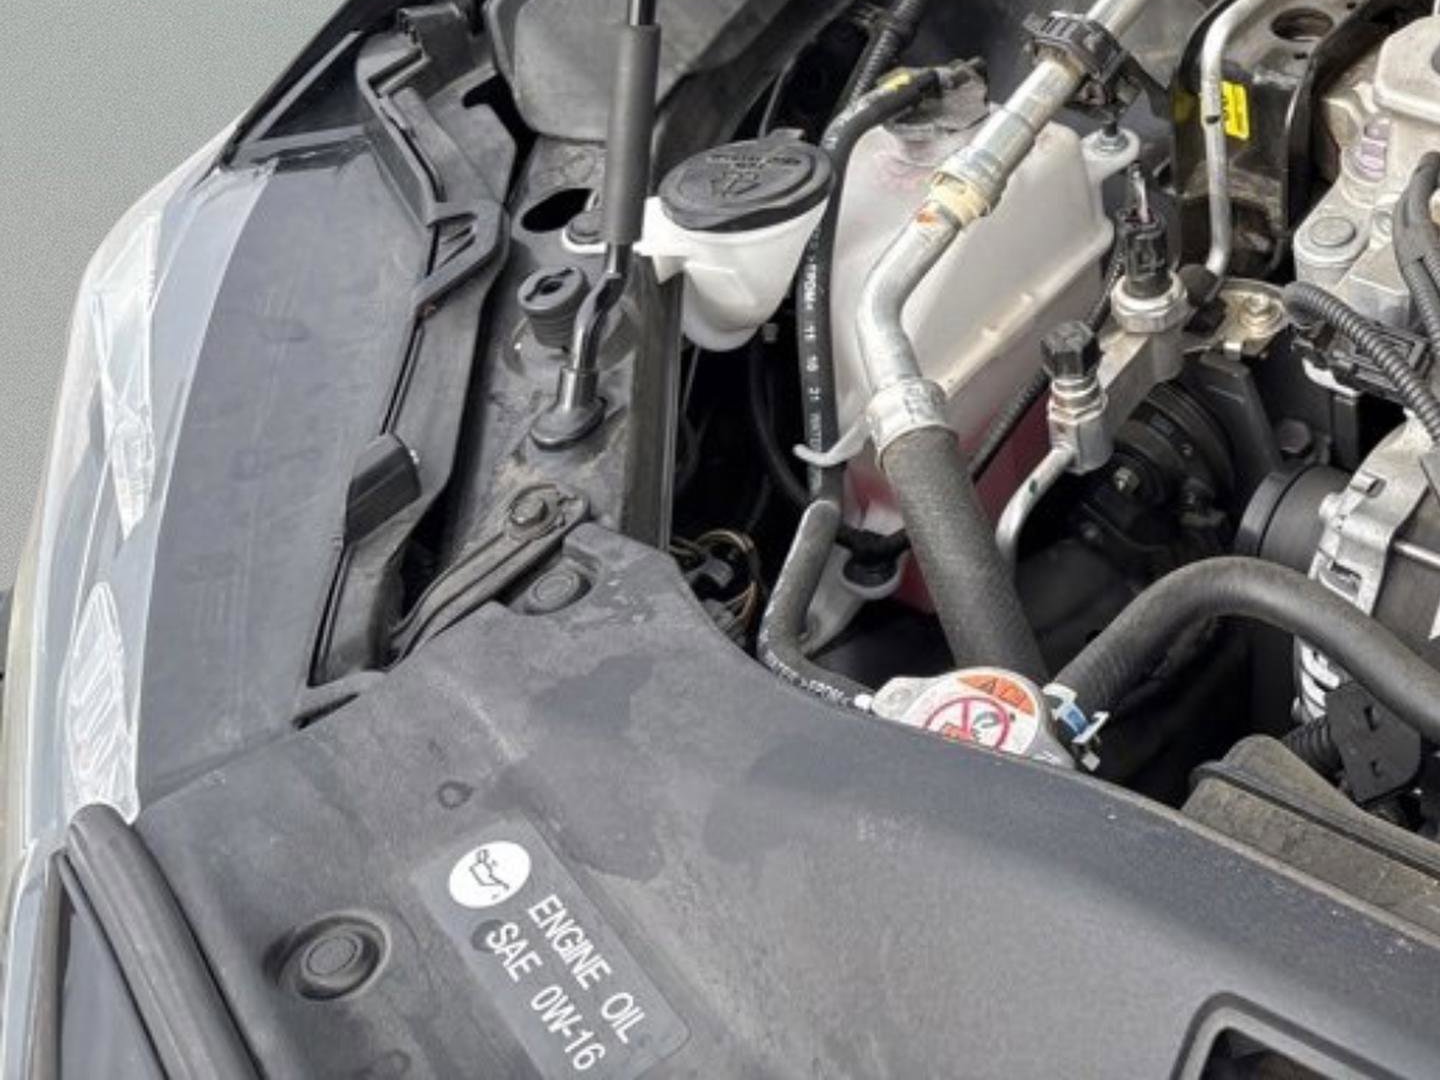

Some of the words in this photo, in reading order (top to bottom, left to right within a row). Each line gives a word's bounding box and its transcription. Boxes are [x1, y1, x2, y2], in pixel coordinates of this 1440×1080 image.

[486, 922, 543, 982] SAE
[530, 985, 606, 1070] 0W-16
[527, 894, 612, 990] ENGINE
[601, 992, 645, 1043] OIL
